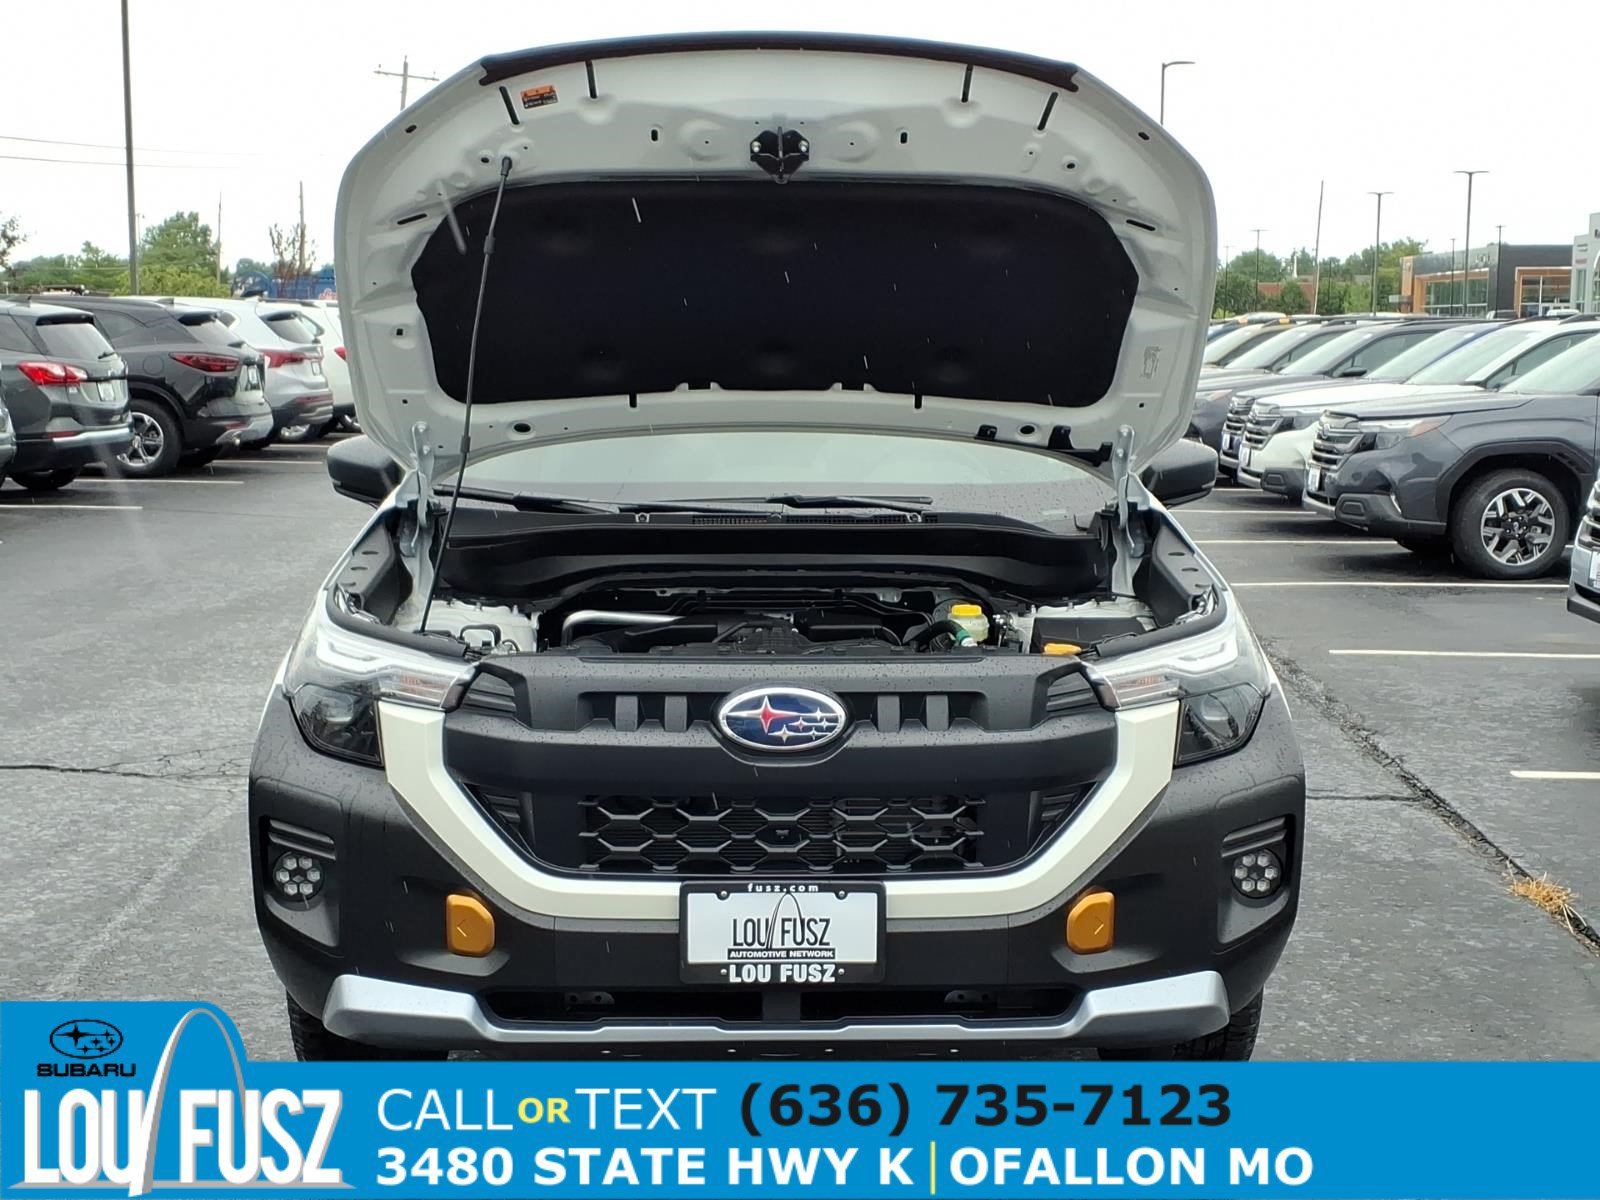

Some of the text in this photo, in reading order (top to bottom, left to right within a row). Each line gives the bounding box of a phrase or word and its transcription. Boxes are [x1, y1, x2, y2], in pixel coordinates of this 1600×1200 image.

[747, 883, 819, 893] fusz.com
[732, 918, 831, 947] LOU FUSZ
[729, 950, 834, 959] AUTOMOTIVE NETWORK
[729, 964, 836, 983] LOU FUSZ
